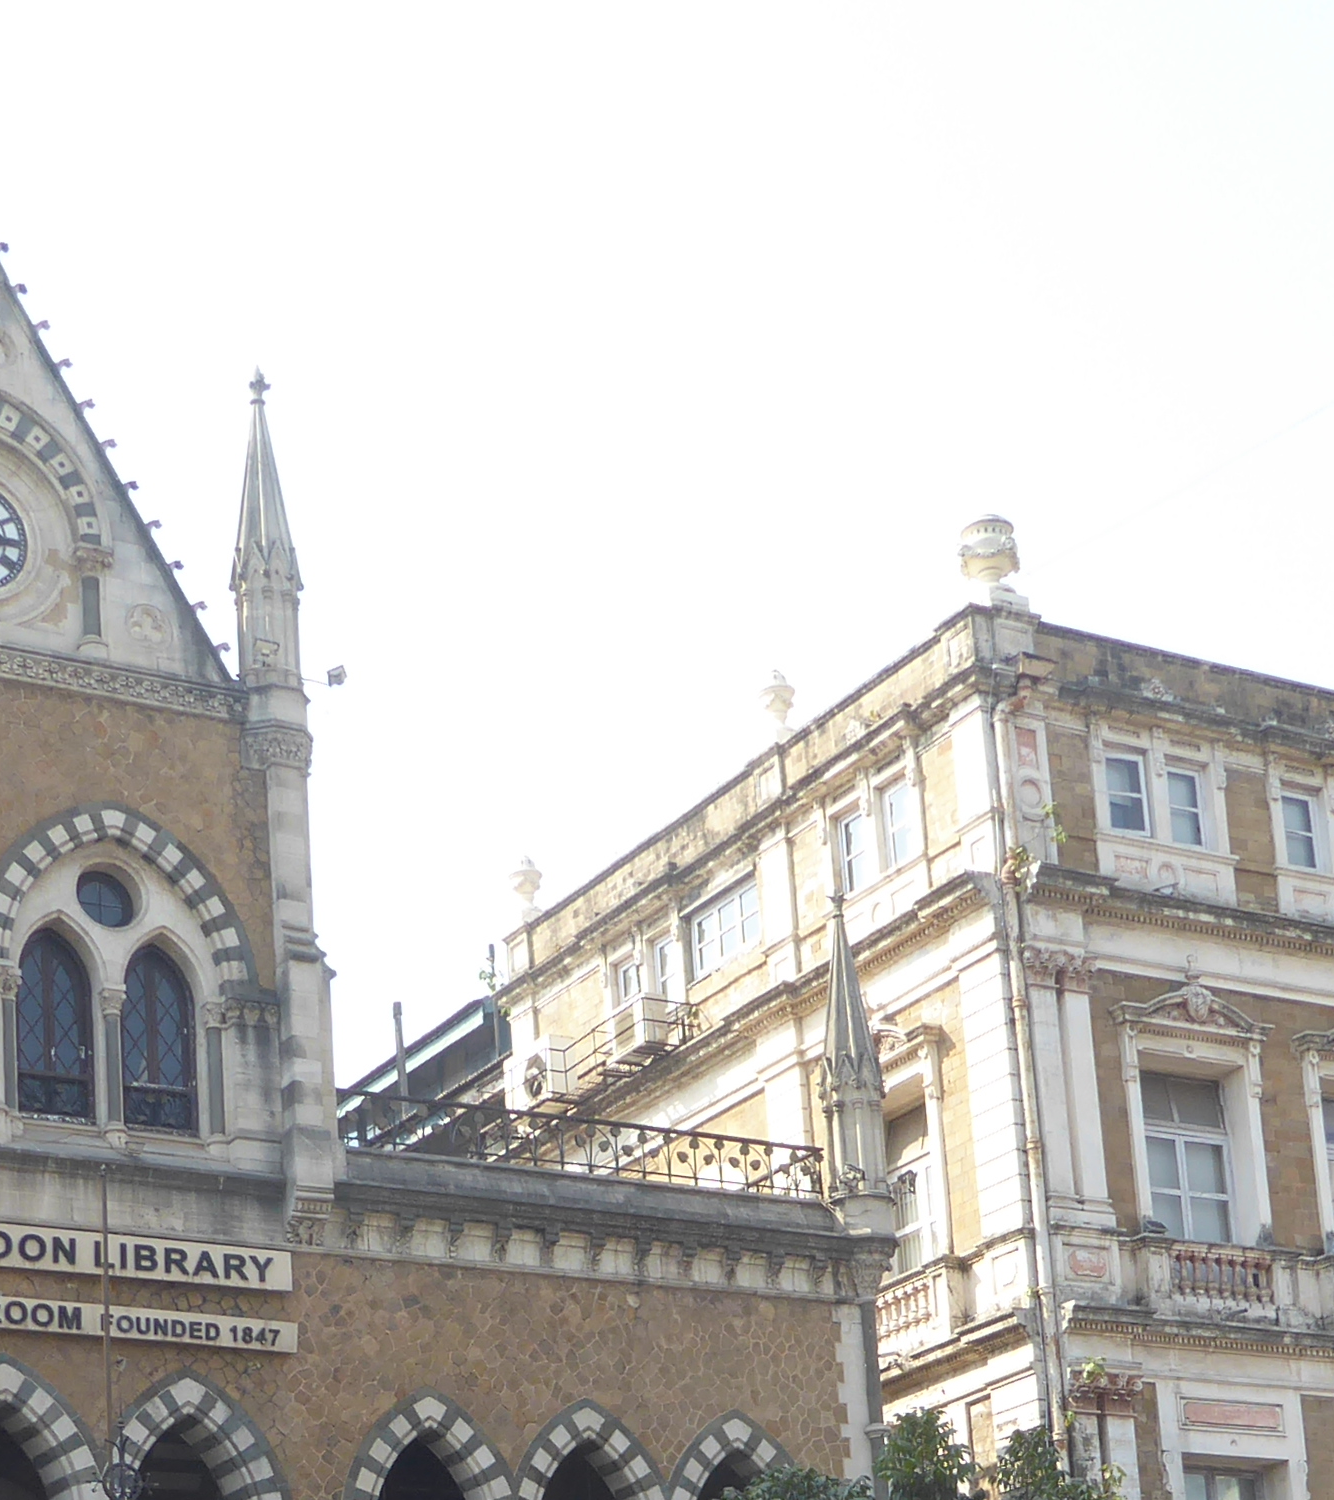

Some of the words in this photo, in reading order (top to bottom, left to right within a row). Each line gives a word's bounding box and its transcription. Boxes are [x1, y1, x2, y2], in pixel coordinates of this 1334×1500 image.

[94, 1239, 274, 1283] LIBRARY
[101, 1313, 221, 1342] FOUNDED
[229, 1325, 281, 1347] 1847
